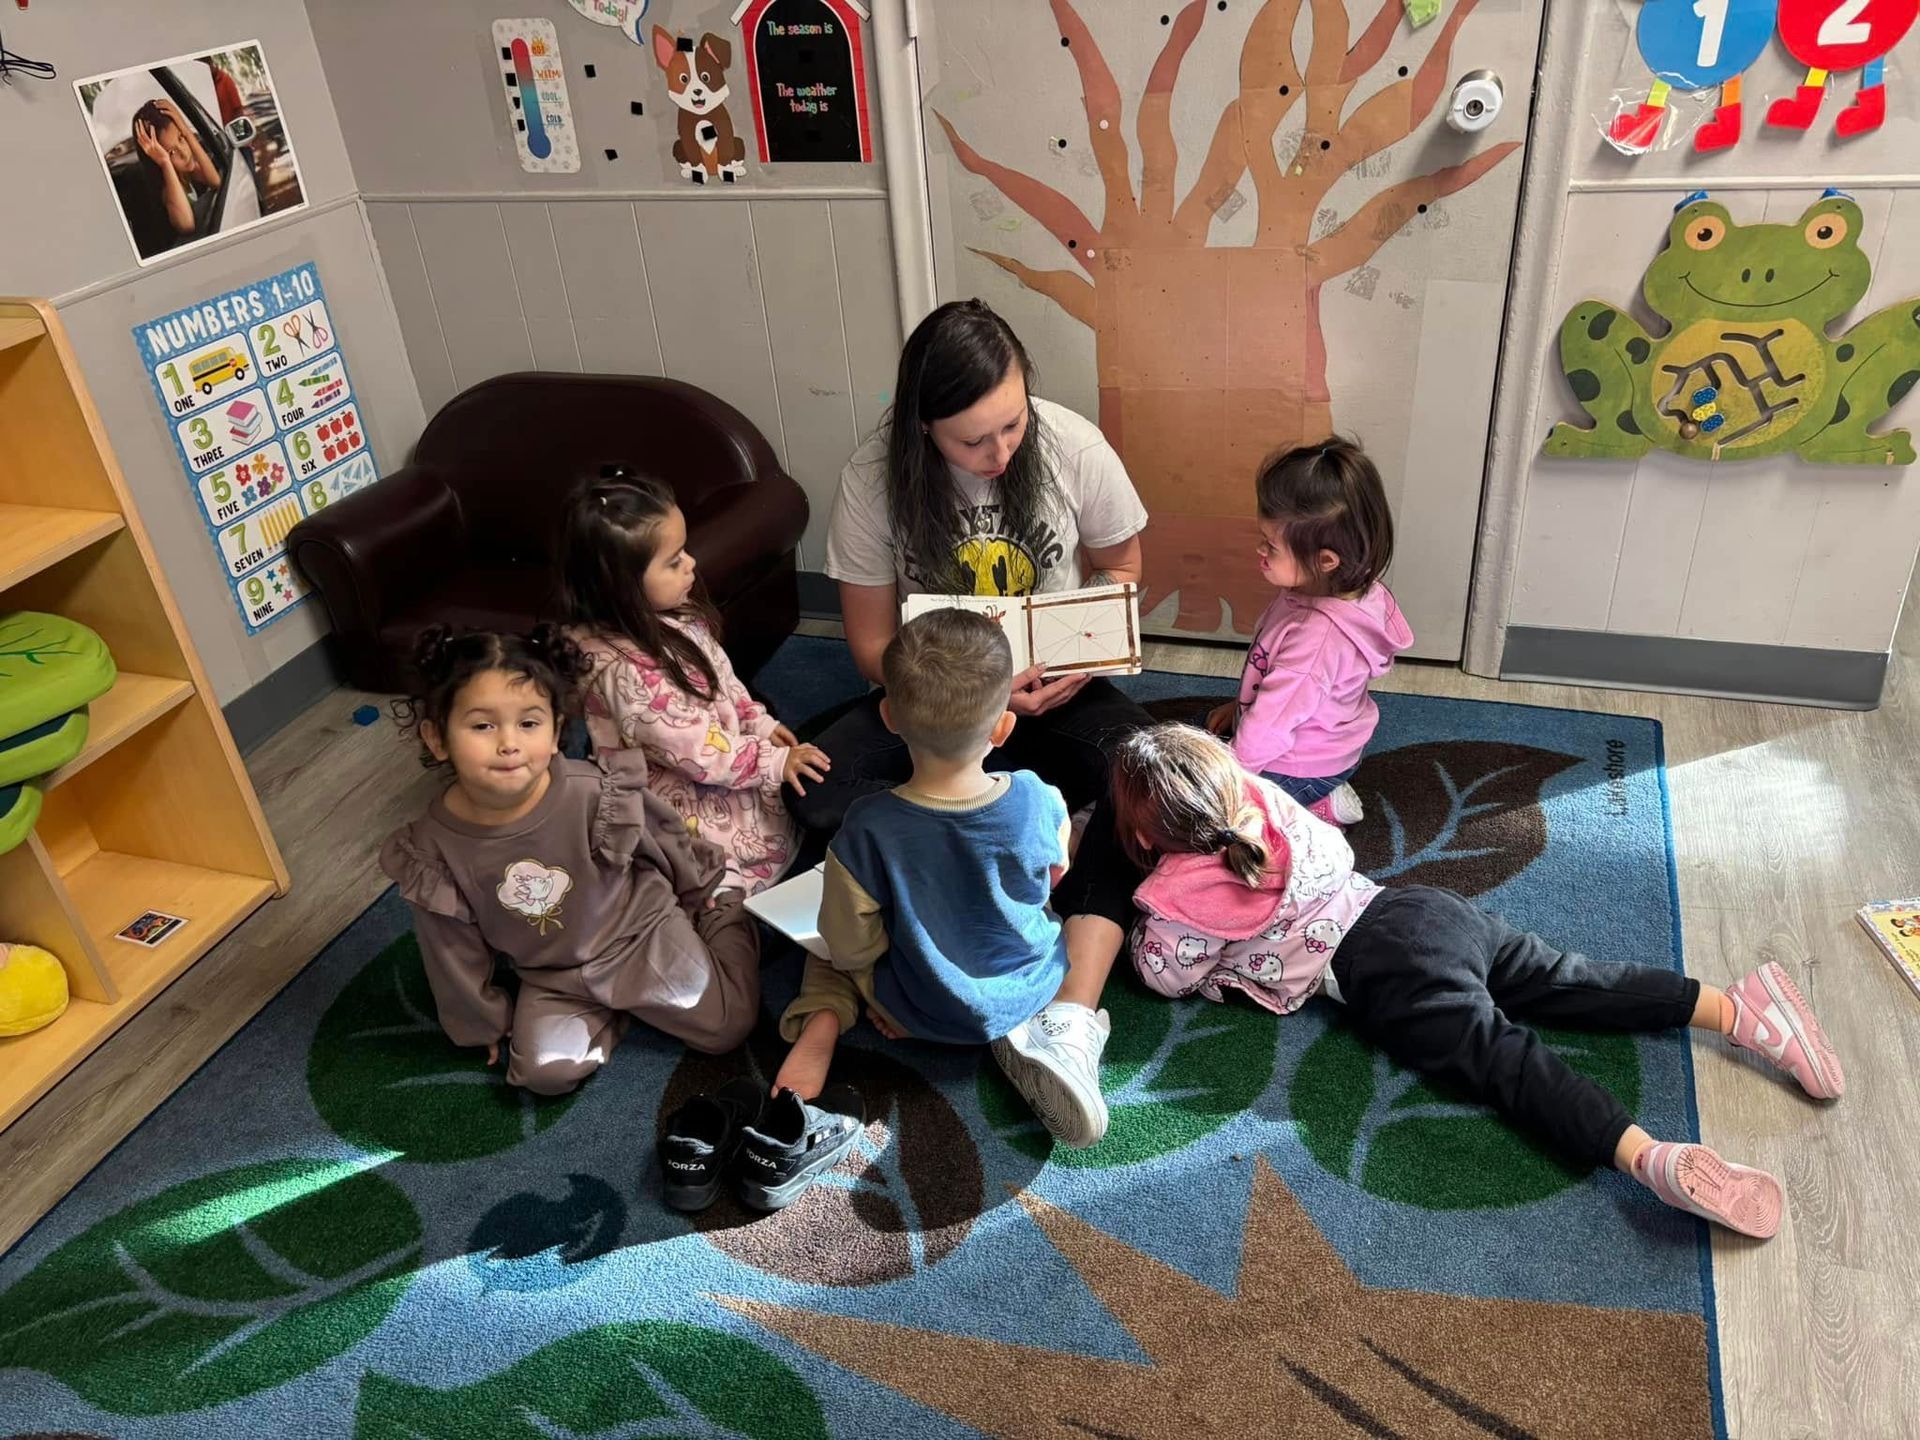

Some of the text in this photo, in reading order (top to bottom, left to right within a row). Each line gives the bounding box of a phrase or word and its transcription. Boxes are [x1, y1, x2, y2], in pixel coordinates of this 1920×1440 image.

[766, 20, 833, 36] The season is
[1692, 0, 1729, 67] 1
[776, 82, 837, 97] The weather
[789, 99, 829, 114] today is
[146, 270, 315, 356] NUMBERS 1-10
[258, 324, 281, 357] 2
[265, 355, 287, 372] TWO
[162, 362, 185, 397] 1
[174, 395, 195, 412] ONE
[276, 378, 294, 408] 4
[281, 407, 305, 426] FOUR
[189, 418, 213, 450] 3
[292, 431, 311, 460] 6
[193, 446, 225, 469] THREE
[301, 459, 317, 475] SIX
[210, 471, 232, 503] 5
[309, 481, 327, 509] 8
[217, 500, 240, 520] FIVE
[228, 523, 248, 555] 7
[234, 548, 264, 573] SEVEN
[245, 577, 264, 606] 9
[253, 601, 274, 621] NINE
